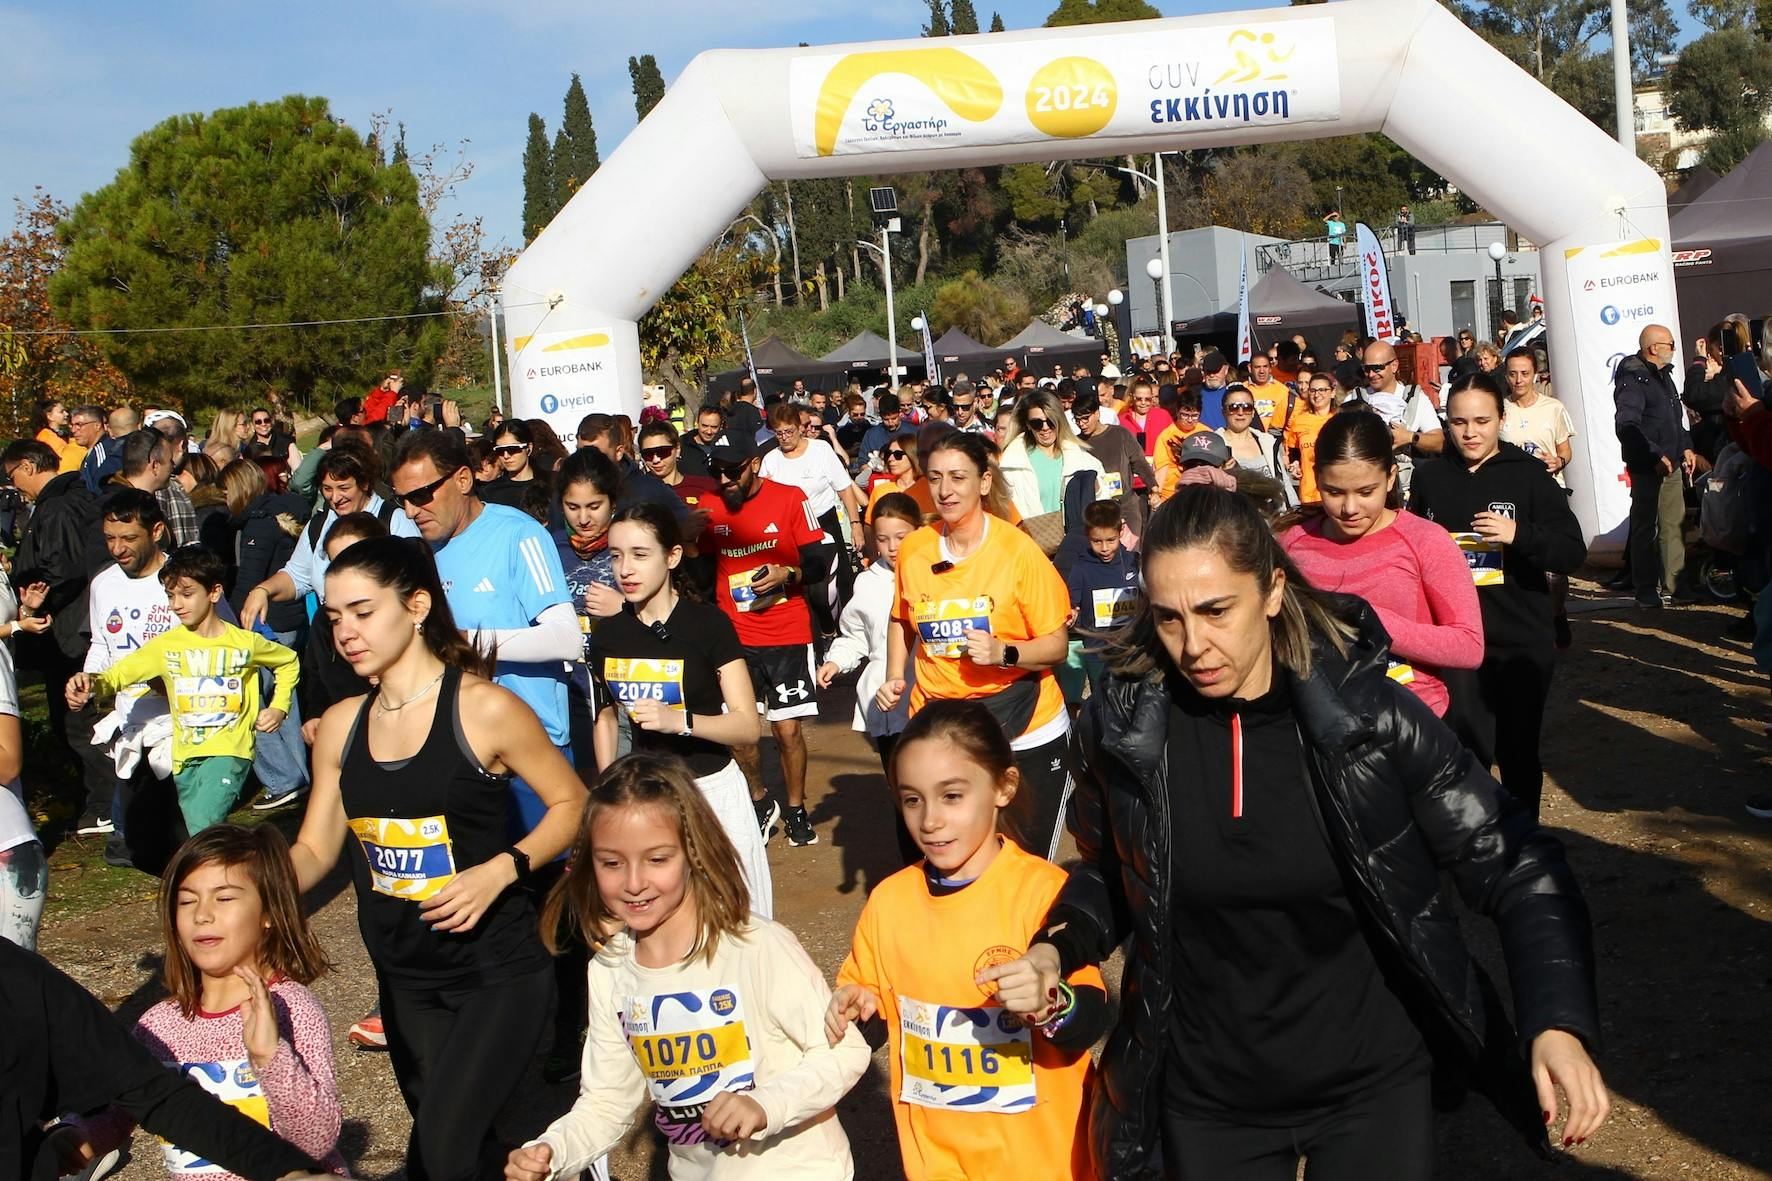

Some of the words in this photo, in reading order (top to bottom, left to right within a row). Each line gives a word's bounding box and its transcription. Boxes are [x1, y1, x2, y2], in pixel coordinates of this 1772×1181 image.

[1034, 82, 1109, 112] 2024
[1150, 88, 1289, 123] εκκίνηση
[1600, 272, 1660, 288] EUROBANK
[540, 361, 603, 377] EUROBANK
[721, 539, 778, 558] #BERLINHALF
[147, 613, 172, 623] RUN
[145, 623, 171, 632] 2024
[930, 619, 974, 637] 2083
[618, 683, 664, 700] 2076
[189, 695, 228, 708] 1073
[423, 823, 440, 835] 2.5K
[374, 846, 424, 872] 2077
[642, 1033, 717, 1066] 1070
[923, 1043, 999, 1074] 1116
[649, 1070, 686, 1079] ΕΣΠΟΙΝΑ
